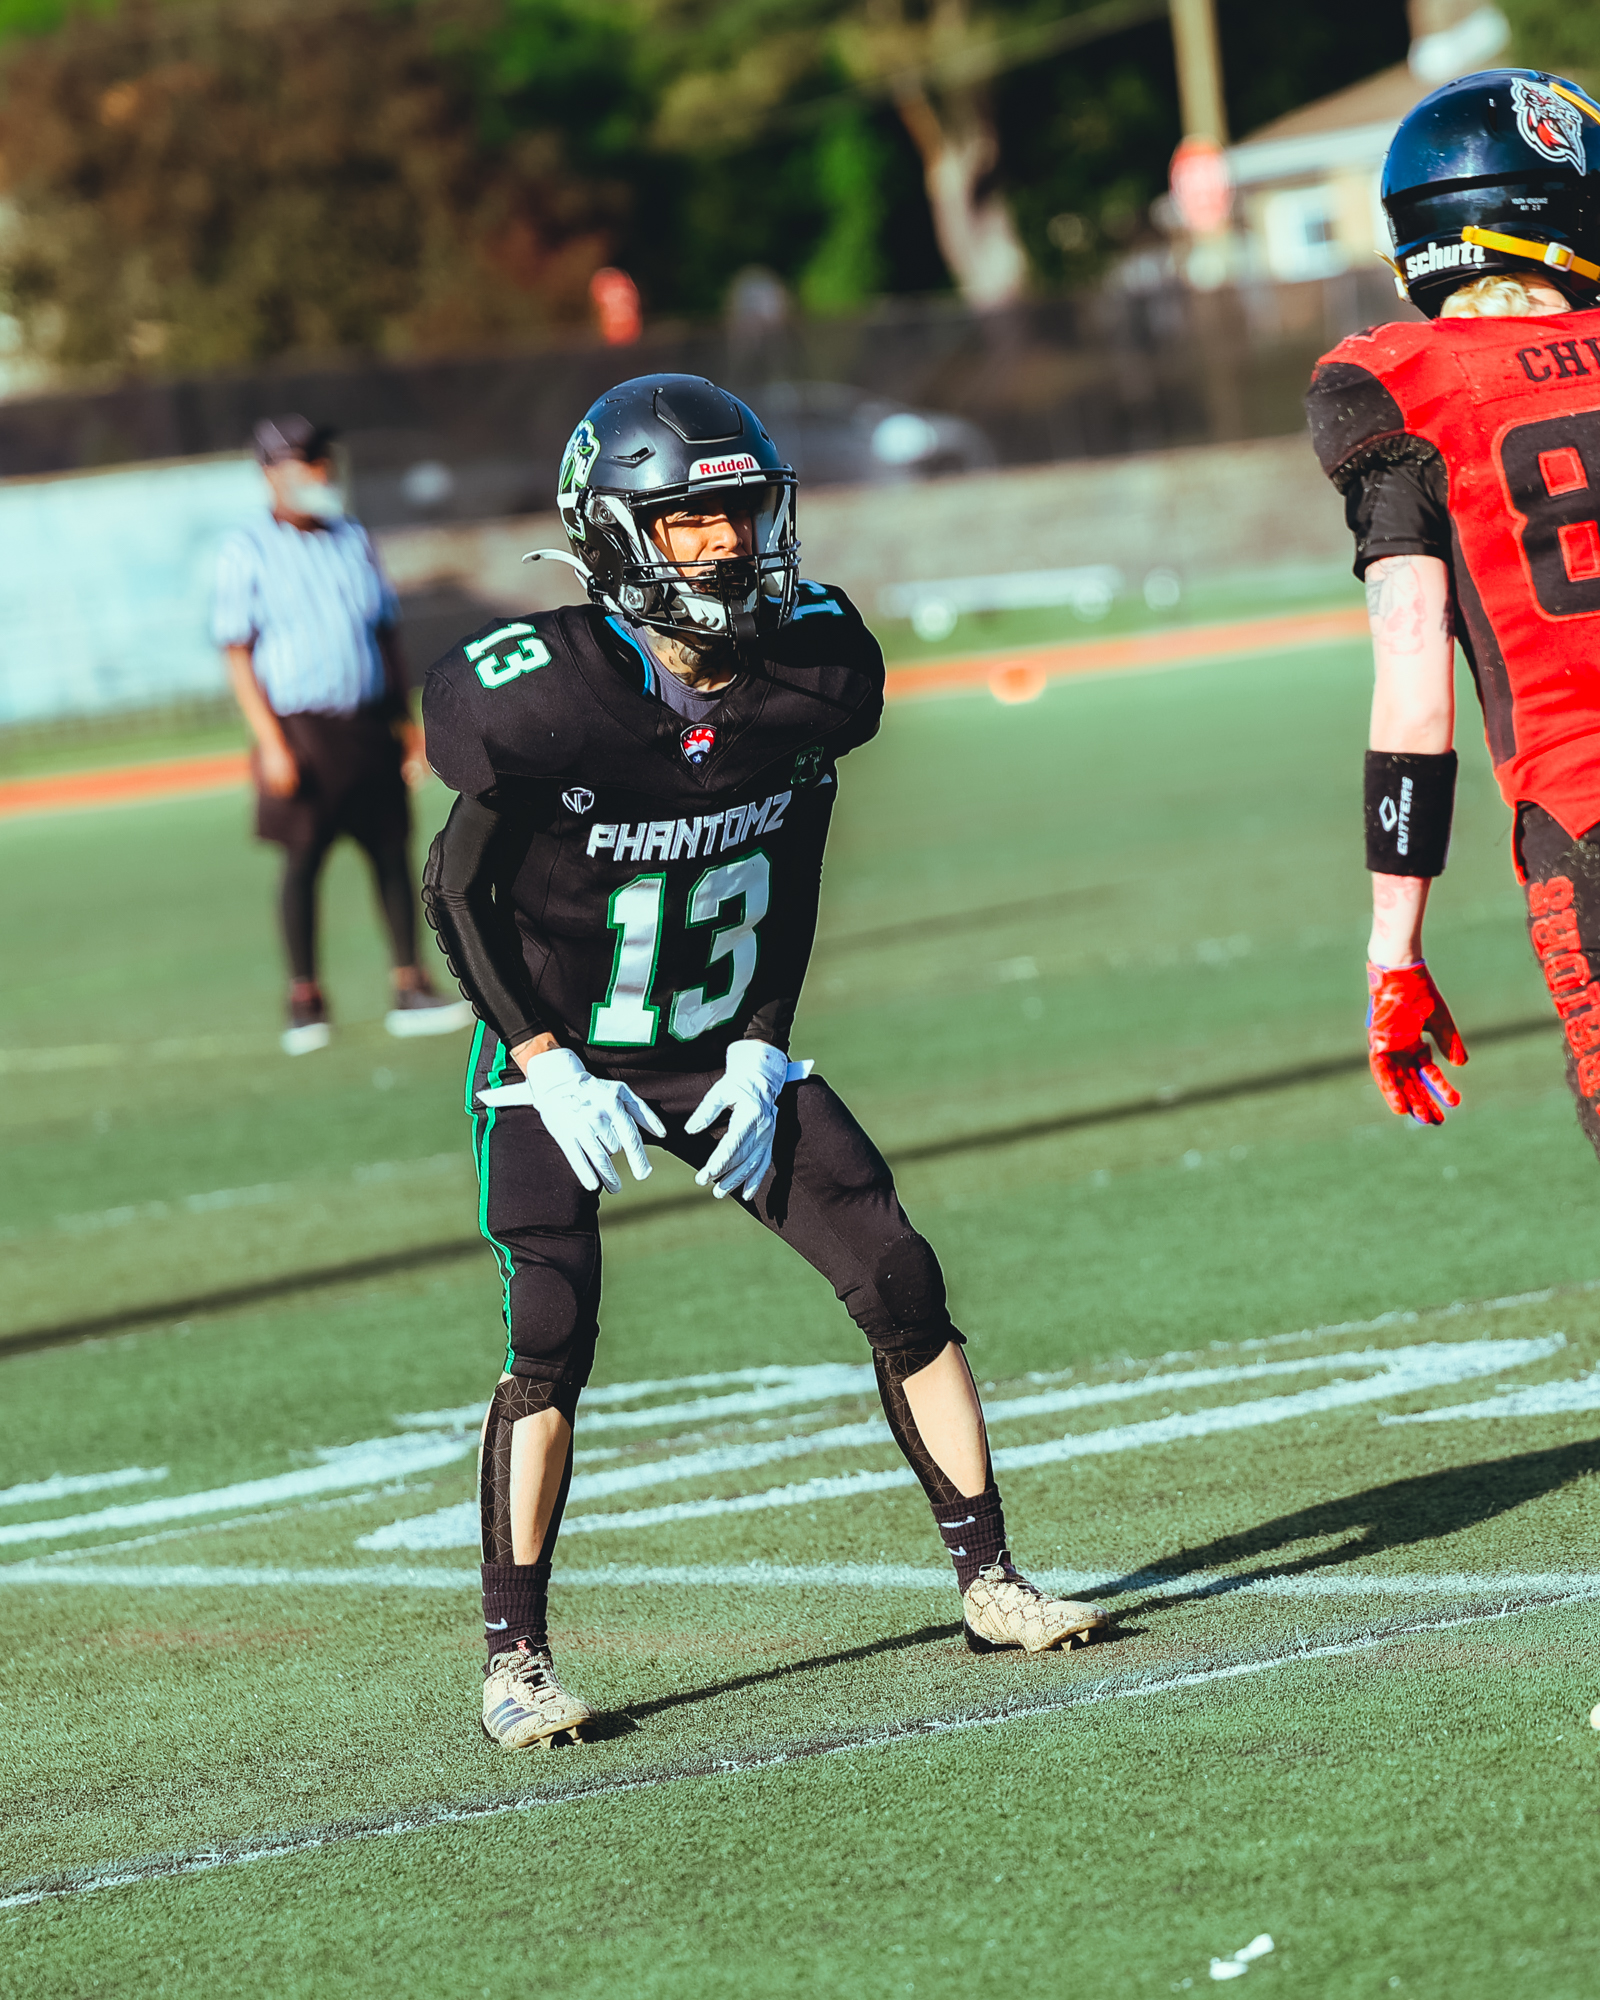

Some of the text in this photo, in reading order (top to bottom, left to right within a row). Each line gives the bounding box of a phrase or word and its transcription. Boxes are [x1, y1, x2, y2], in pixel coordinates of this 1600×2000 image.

[699, 457, 754, 475] Riddell
[464, 622, 552, 689] 13
[1396, 776, 1414, 856] CUTTERS
[587, 847, 773, 1047] 13
